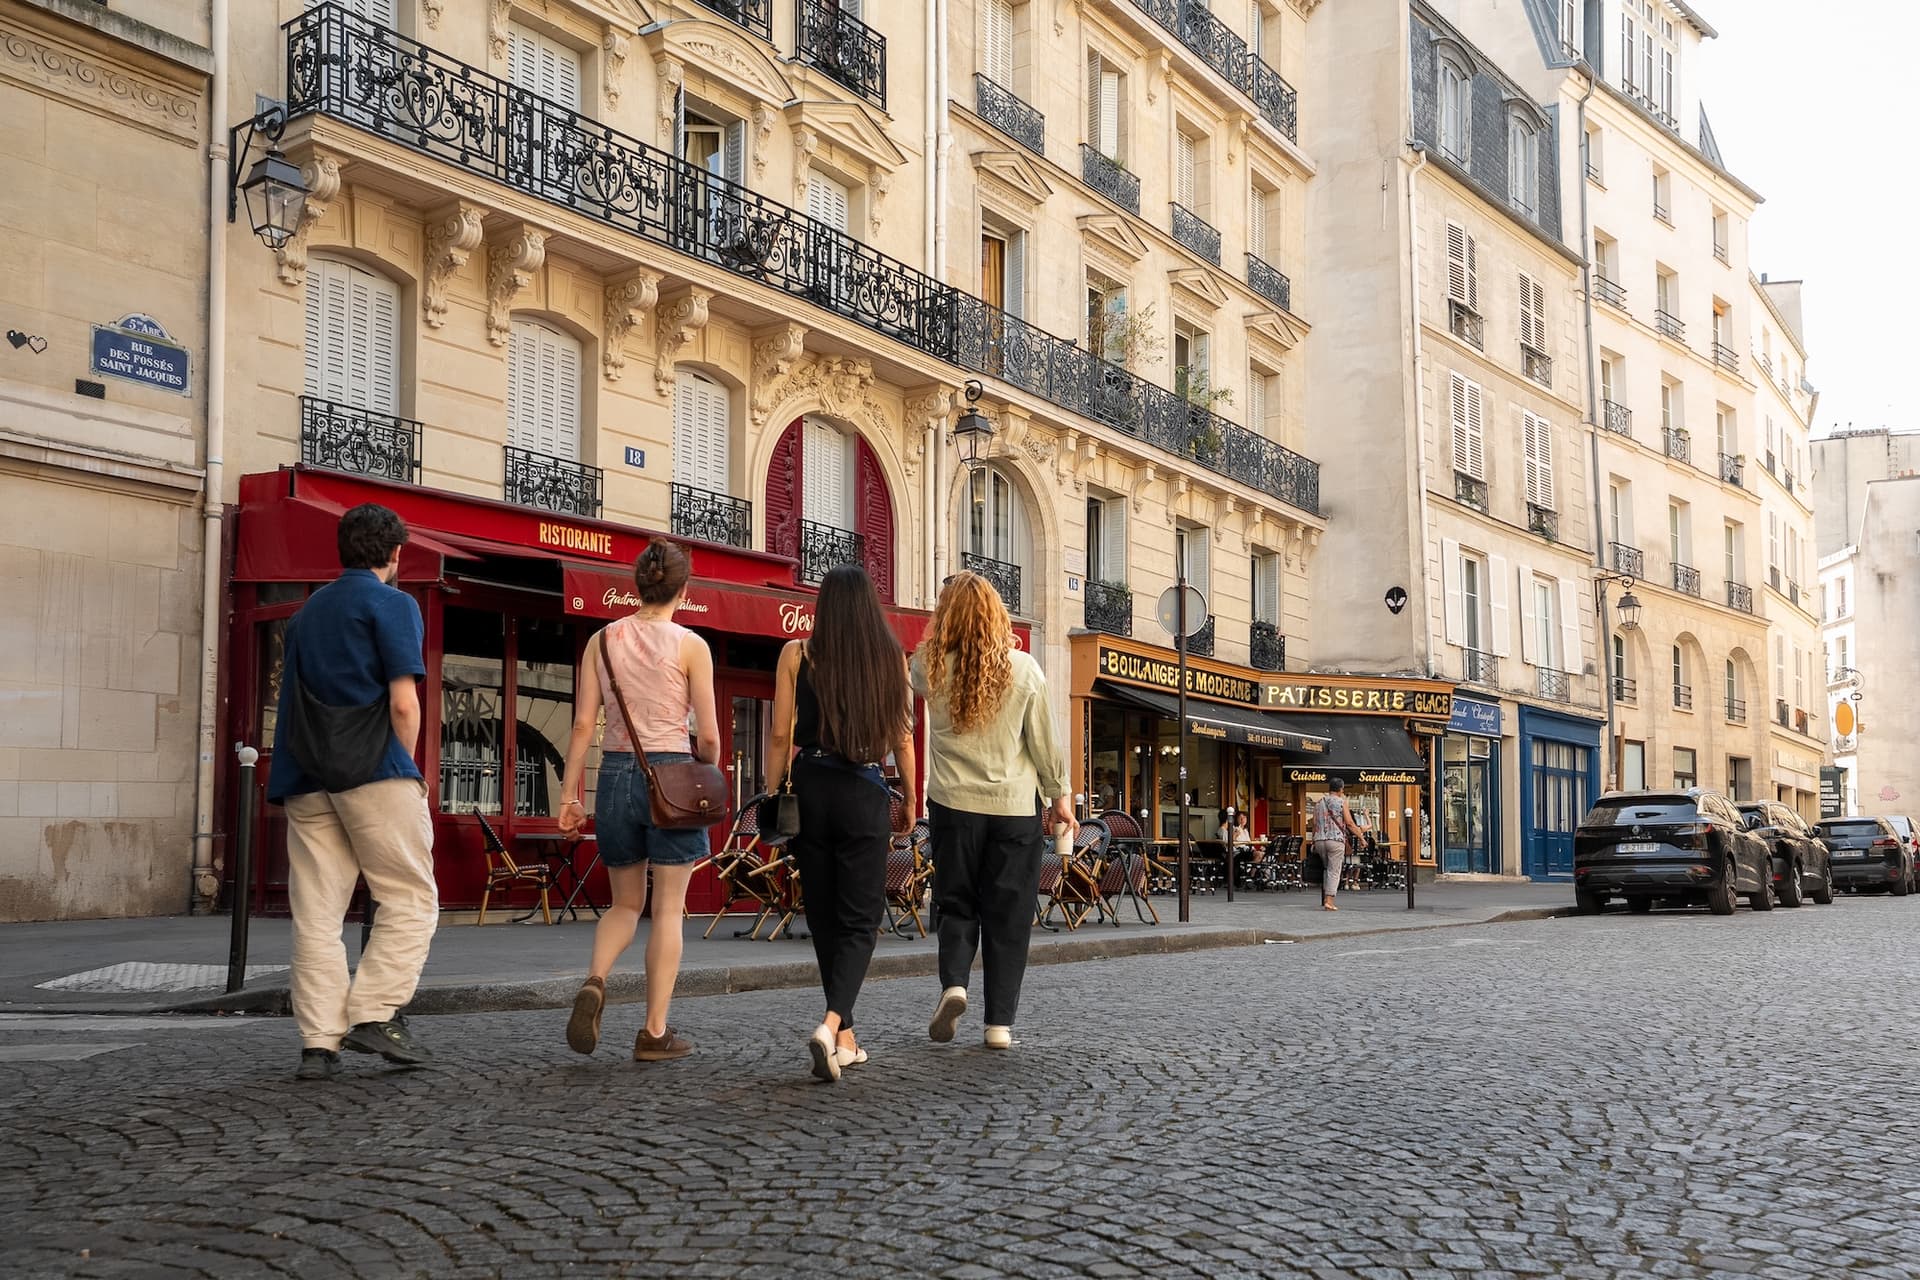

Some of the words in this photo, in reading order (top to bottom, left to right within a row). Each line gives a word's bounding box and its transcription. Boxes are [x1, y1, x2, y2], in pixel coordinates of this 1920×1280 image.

[109, 348, 130, 361] DES
[133, 354, 174, 372] FOSSÉS
[131, 341, 153, 356] RUE
[100, 357, 134, 374] SAINT
[135, 367, 182, 386] JACQUES
[629, 449, 641, 465] 18
[539, 522, 612, 555] RISTORANTE
[602, 587, 642, 608] Gastron
[677, 598, 709, 613] aliana
[779, 603, 815, 634] Ter
[1107, 651, 1193, 690] BOULANGERE
[1196, 672, 1251, 701] MODERNE
[1267, 685, 1406, 709] PATISSERIE
[1414, 693, 1449, 714] GLACE
[1290, 769, 1327, 782] Cuisine
[1358, 770, 1416, 783] Sandwiches
